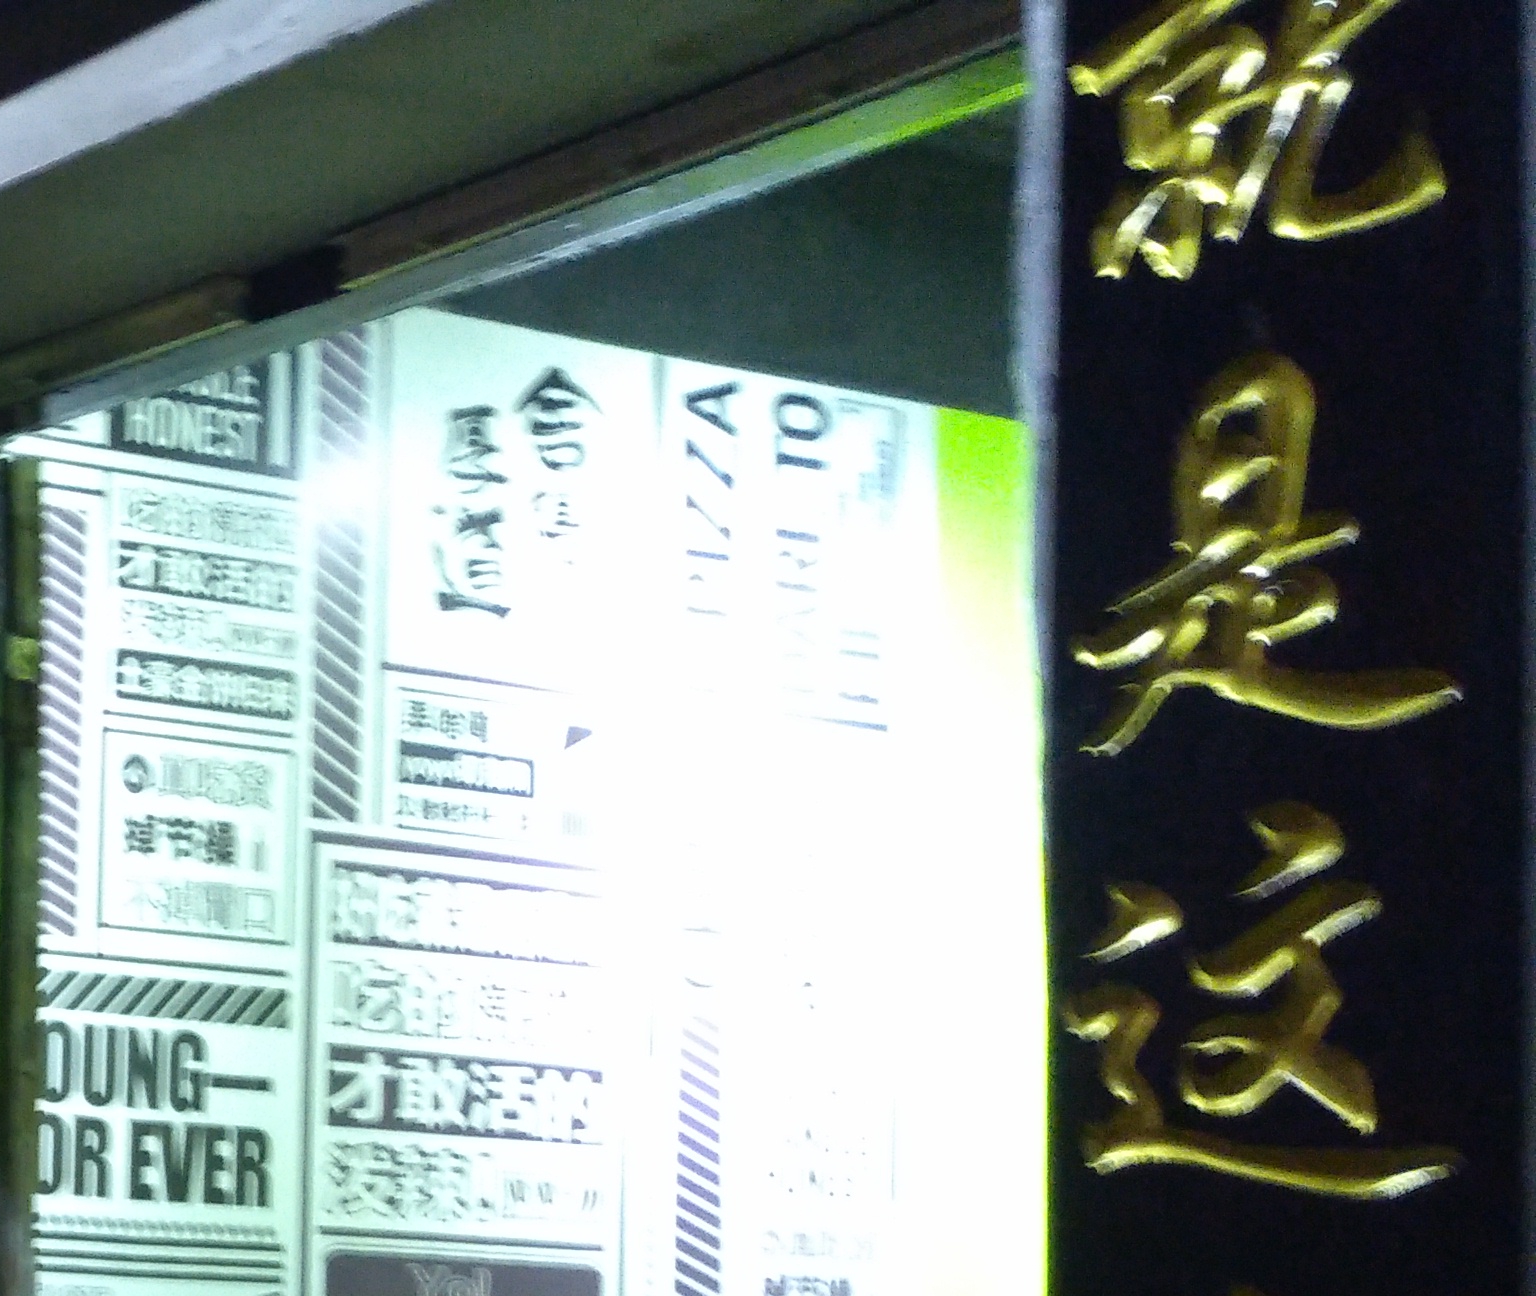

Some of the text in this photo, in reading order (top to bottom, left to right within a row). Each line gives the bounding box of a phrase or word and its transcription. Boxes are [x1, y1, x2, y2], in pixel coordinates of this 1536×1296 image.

[38, 1020, 212, 1114] OUNG
[328, 1050, 604, 1144] 才敢活的
[35, 1111, 275, 1208] OR EVER
